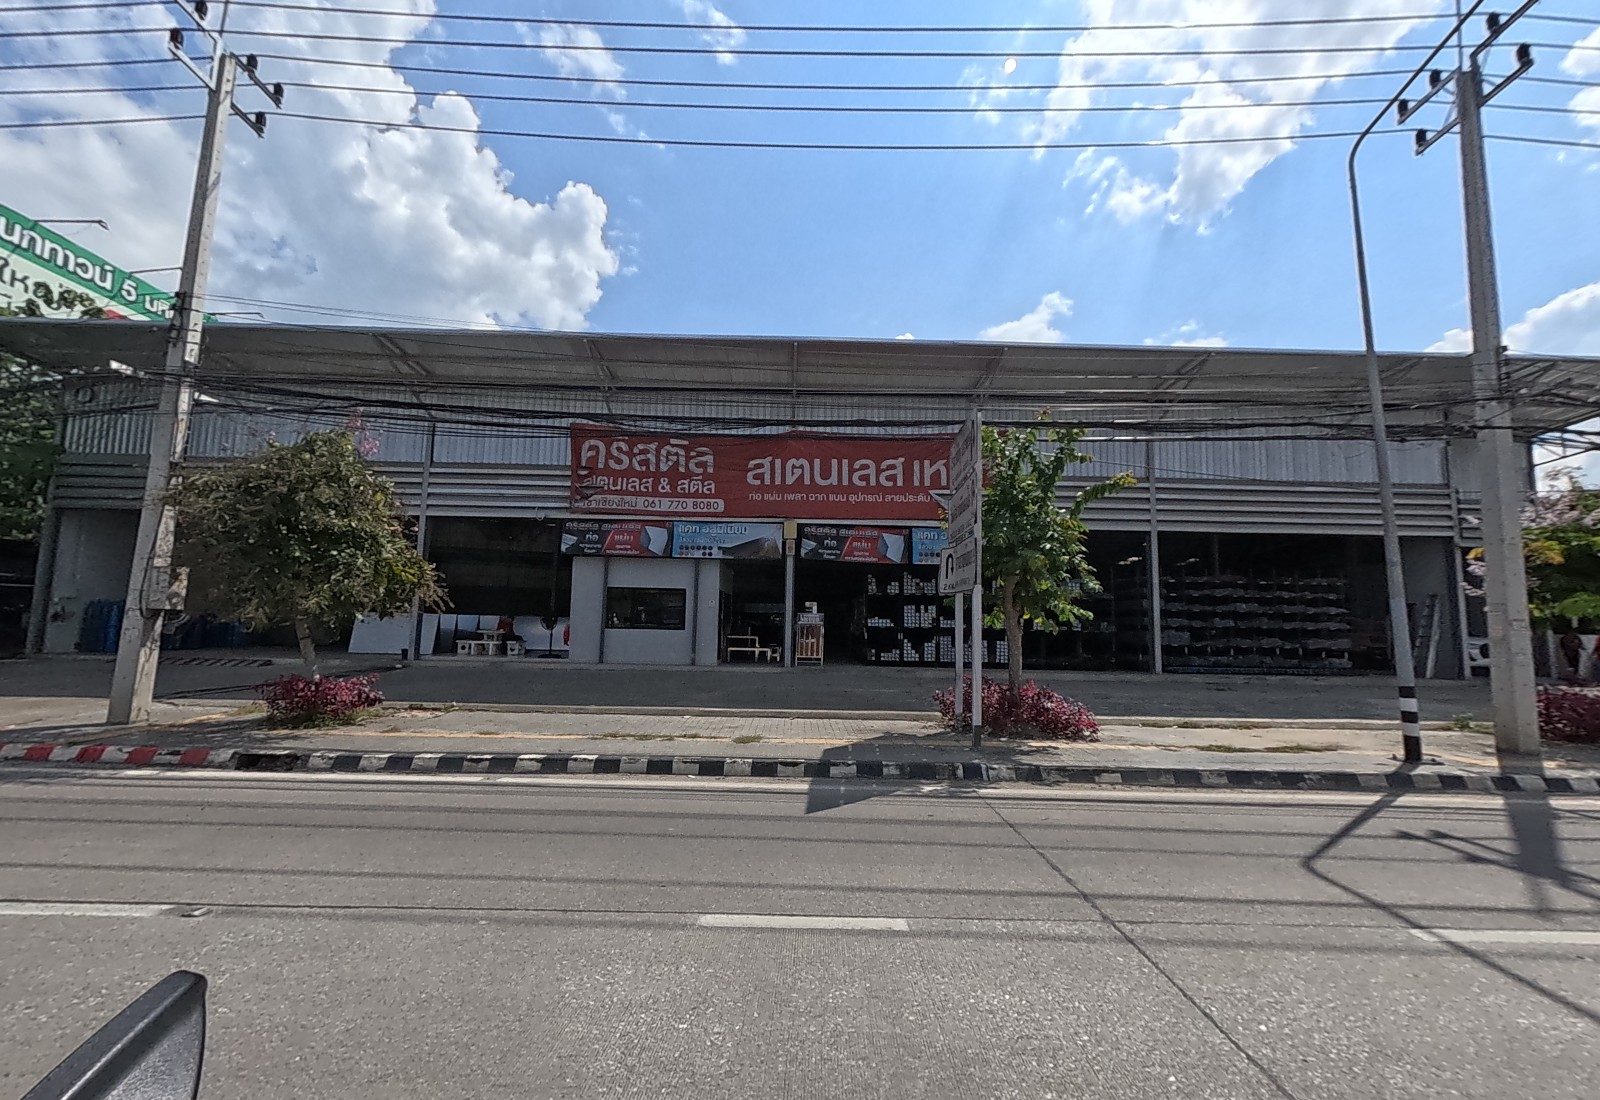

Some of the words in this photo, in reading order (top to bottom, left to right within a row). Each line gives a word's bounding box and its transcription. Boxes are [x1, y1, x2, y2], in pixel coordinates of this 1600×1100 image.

[121, 279, 137, 302] 5
[746, 456, 905, 487] สเตนเลส
[658, 476, 672, 493] &
[677, 475, 716, 495] สตีล
[643, 499, 662, 509] 061
[668, 500, 688, 510] 770
[692, 501, 720, 511] 8080
[748, 491, 761, 501] ท่อ
[784, 493, 806, 501] เพลา
